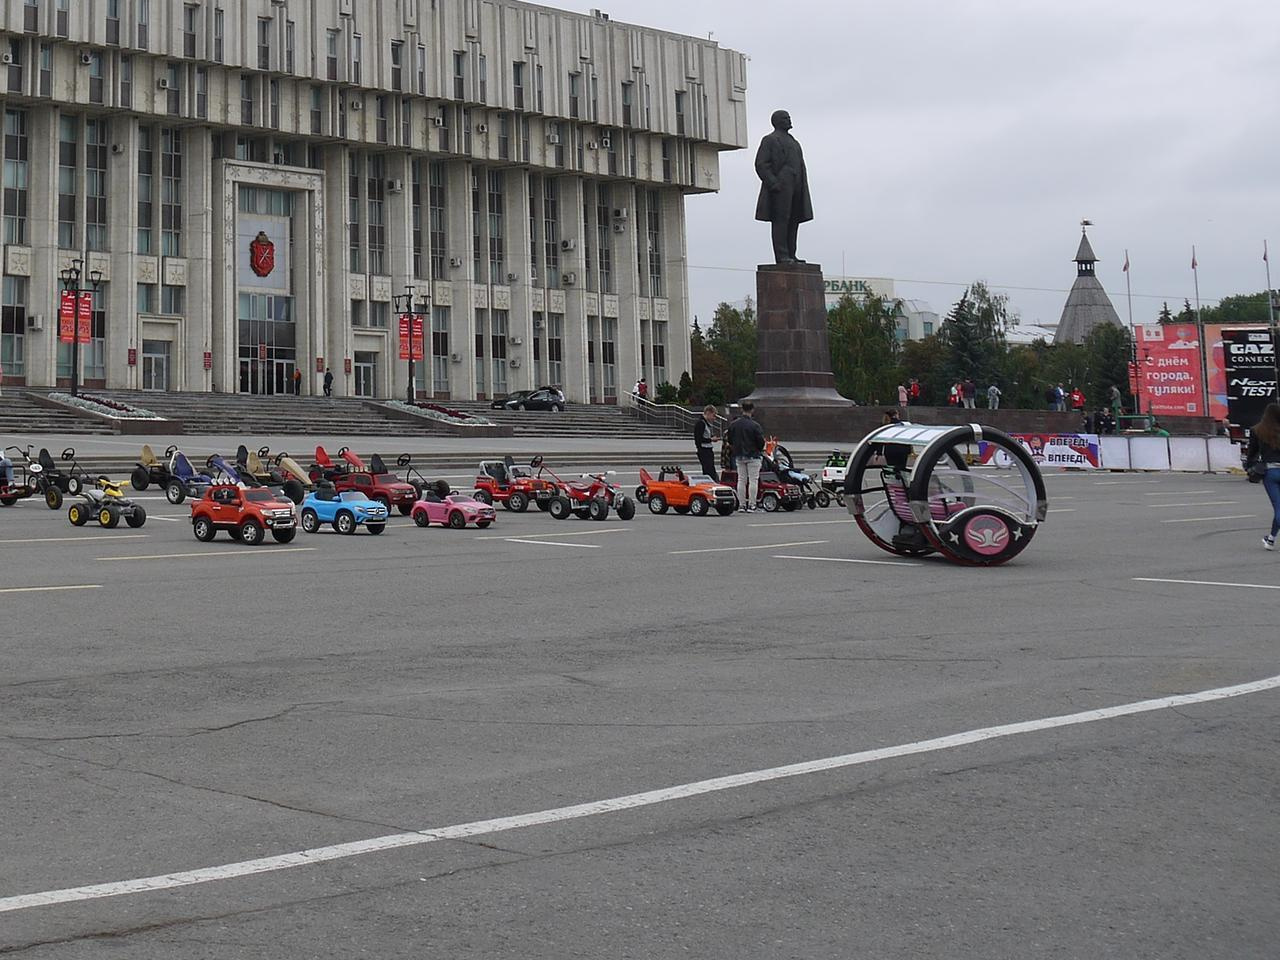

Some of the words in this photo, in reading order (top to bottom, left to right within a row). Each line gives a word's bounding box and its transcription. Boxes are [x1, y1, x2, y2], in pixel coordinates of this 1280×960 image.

[824, 280, 867, 292] РБАНК
[1230, 343, 1275, 354] GAZ
[1158, 355, 1189, 367] днём
[1146, 371, 1194, 382] города,
[1146, 385, 1196, 396] туляки!
[1242, 386, 1276, 396] TEST
